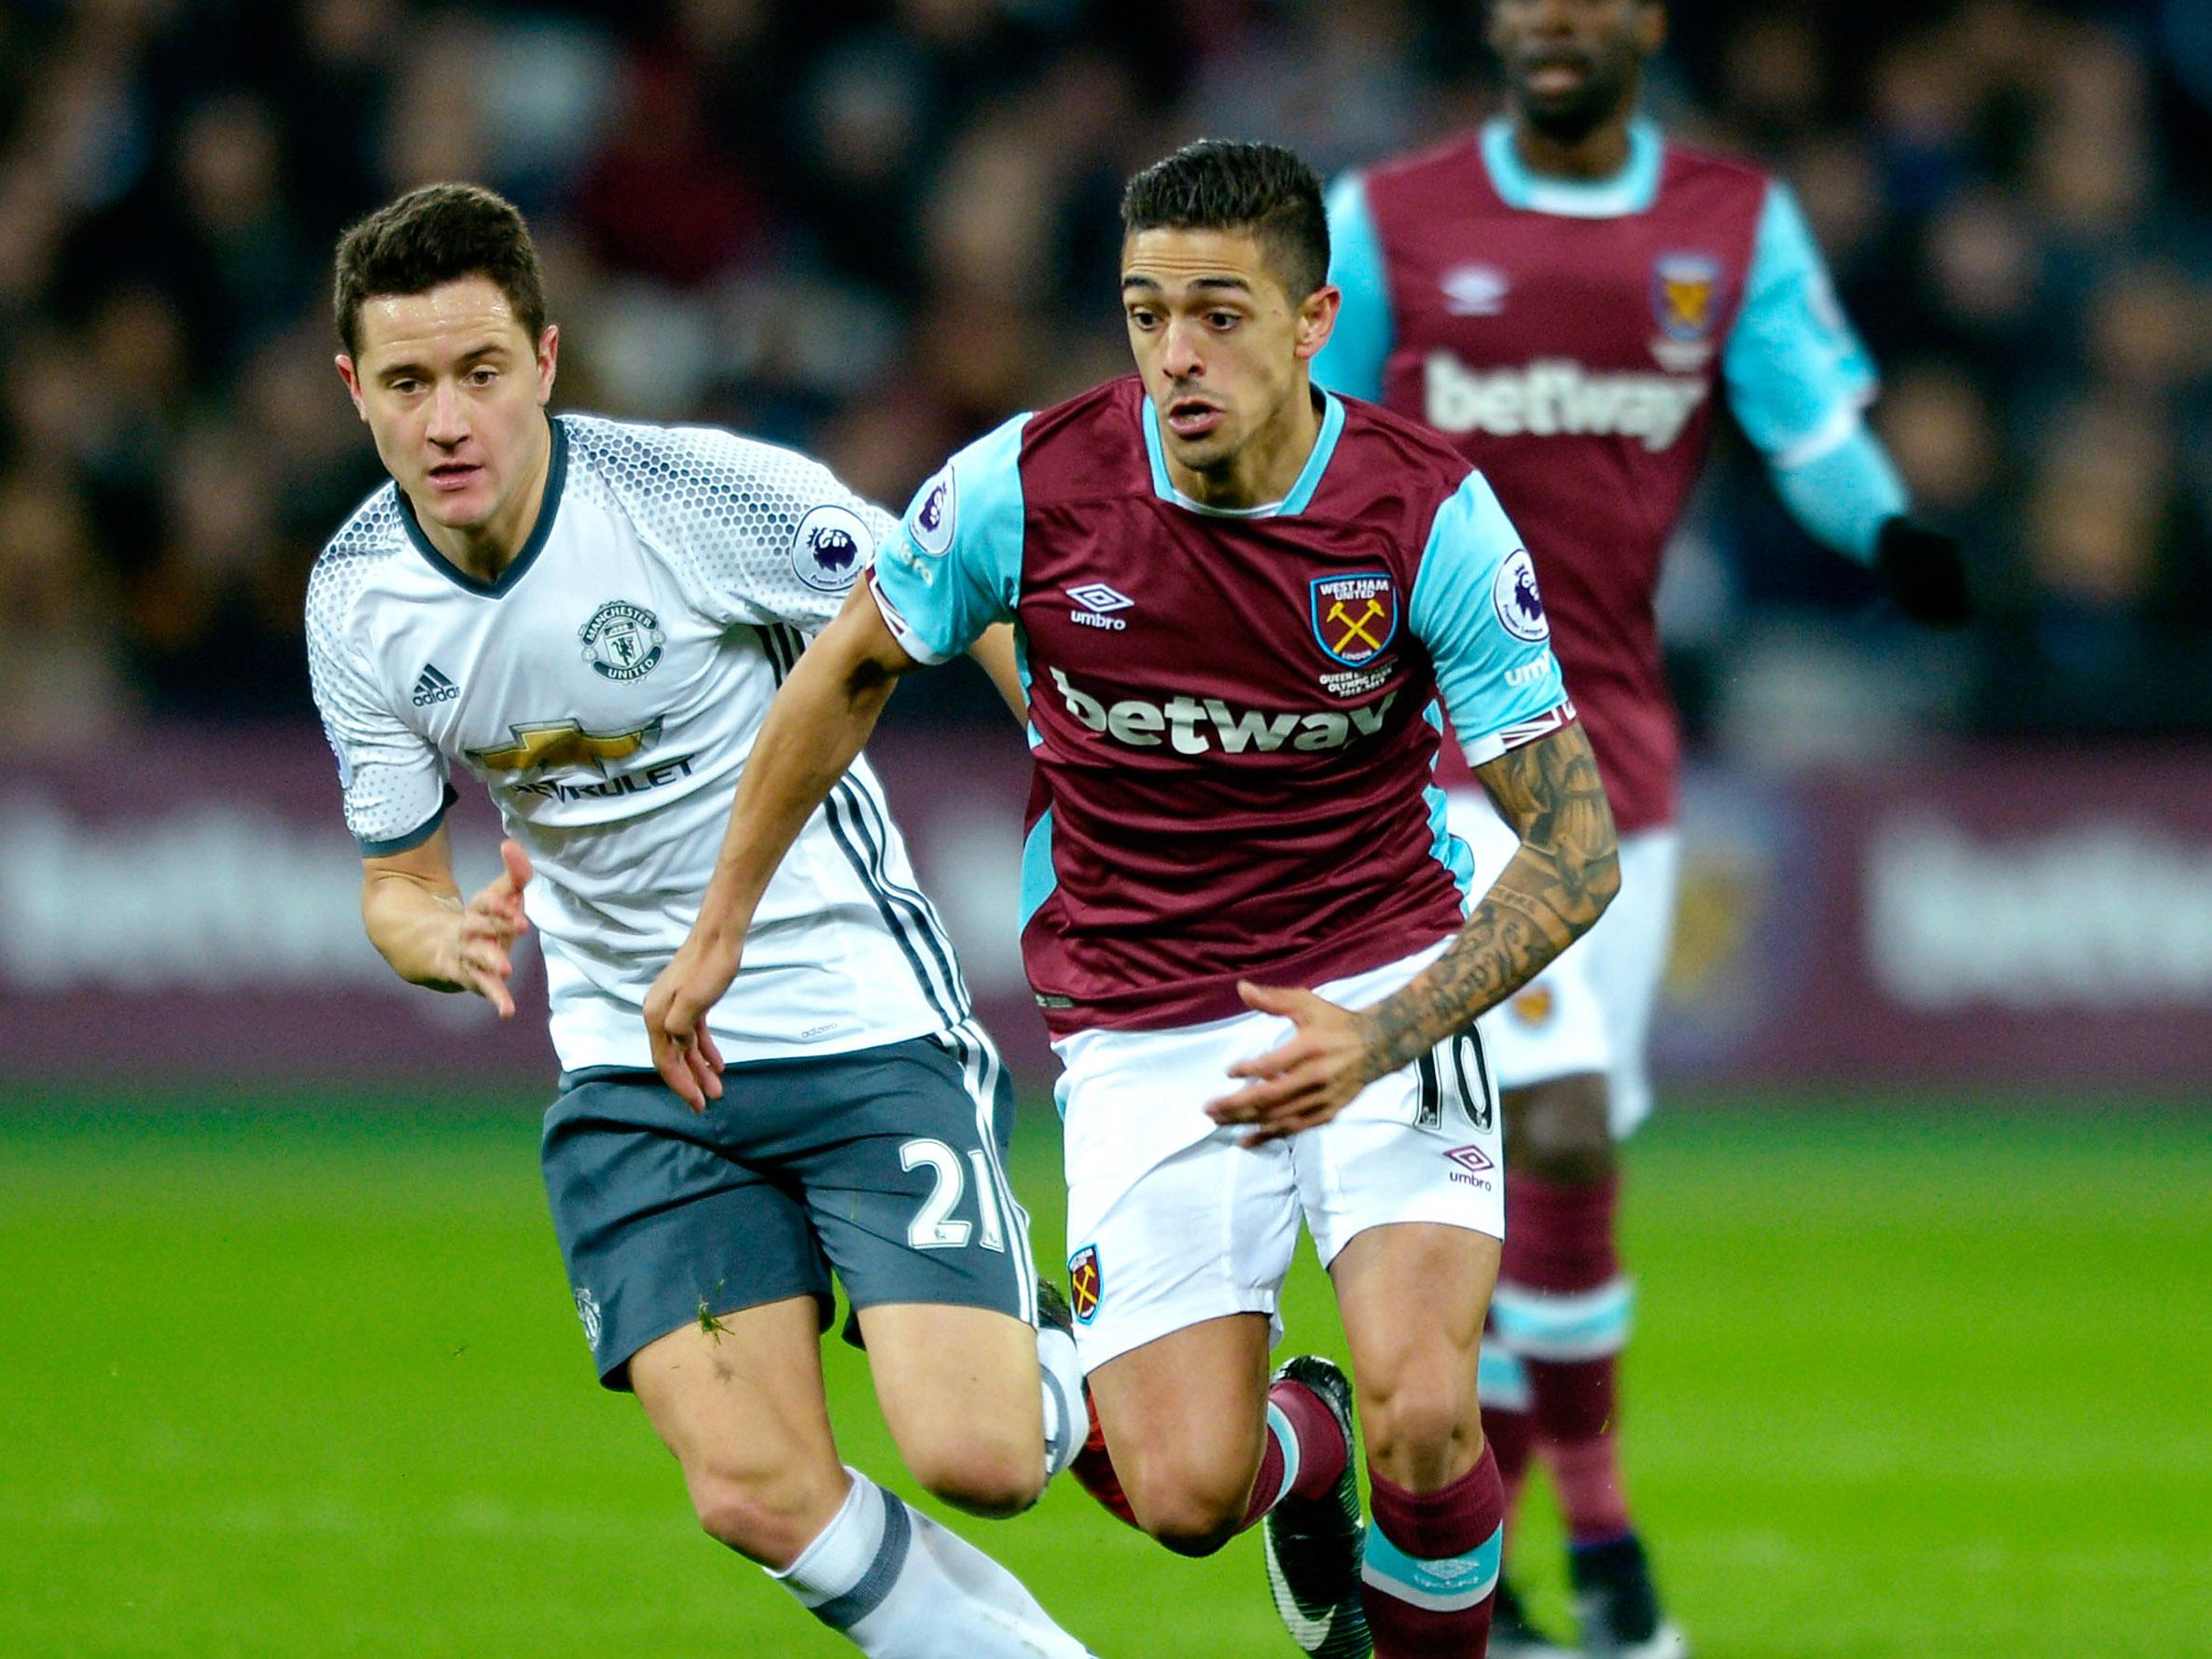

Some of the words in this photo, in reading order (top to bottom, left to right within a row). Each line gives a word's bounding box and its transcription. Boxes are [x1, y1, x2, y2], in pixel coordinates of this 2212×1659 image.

[1319, 579, 1356, 595] WEST
[1356, 579, 1389, 592] HAM
[585, 606, 652, 642] MANCHESTER
[1070, 609, 1127, 631] umbro
[607, 659, 654, 679] UNITED
[1050, 665, 1398, 755] betway
[1412, 1020, 1493, 1136] 10
[899, 1138, 1005, 1253] 21
[1449, 1171, 1492, 1192] umbro
